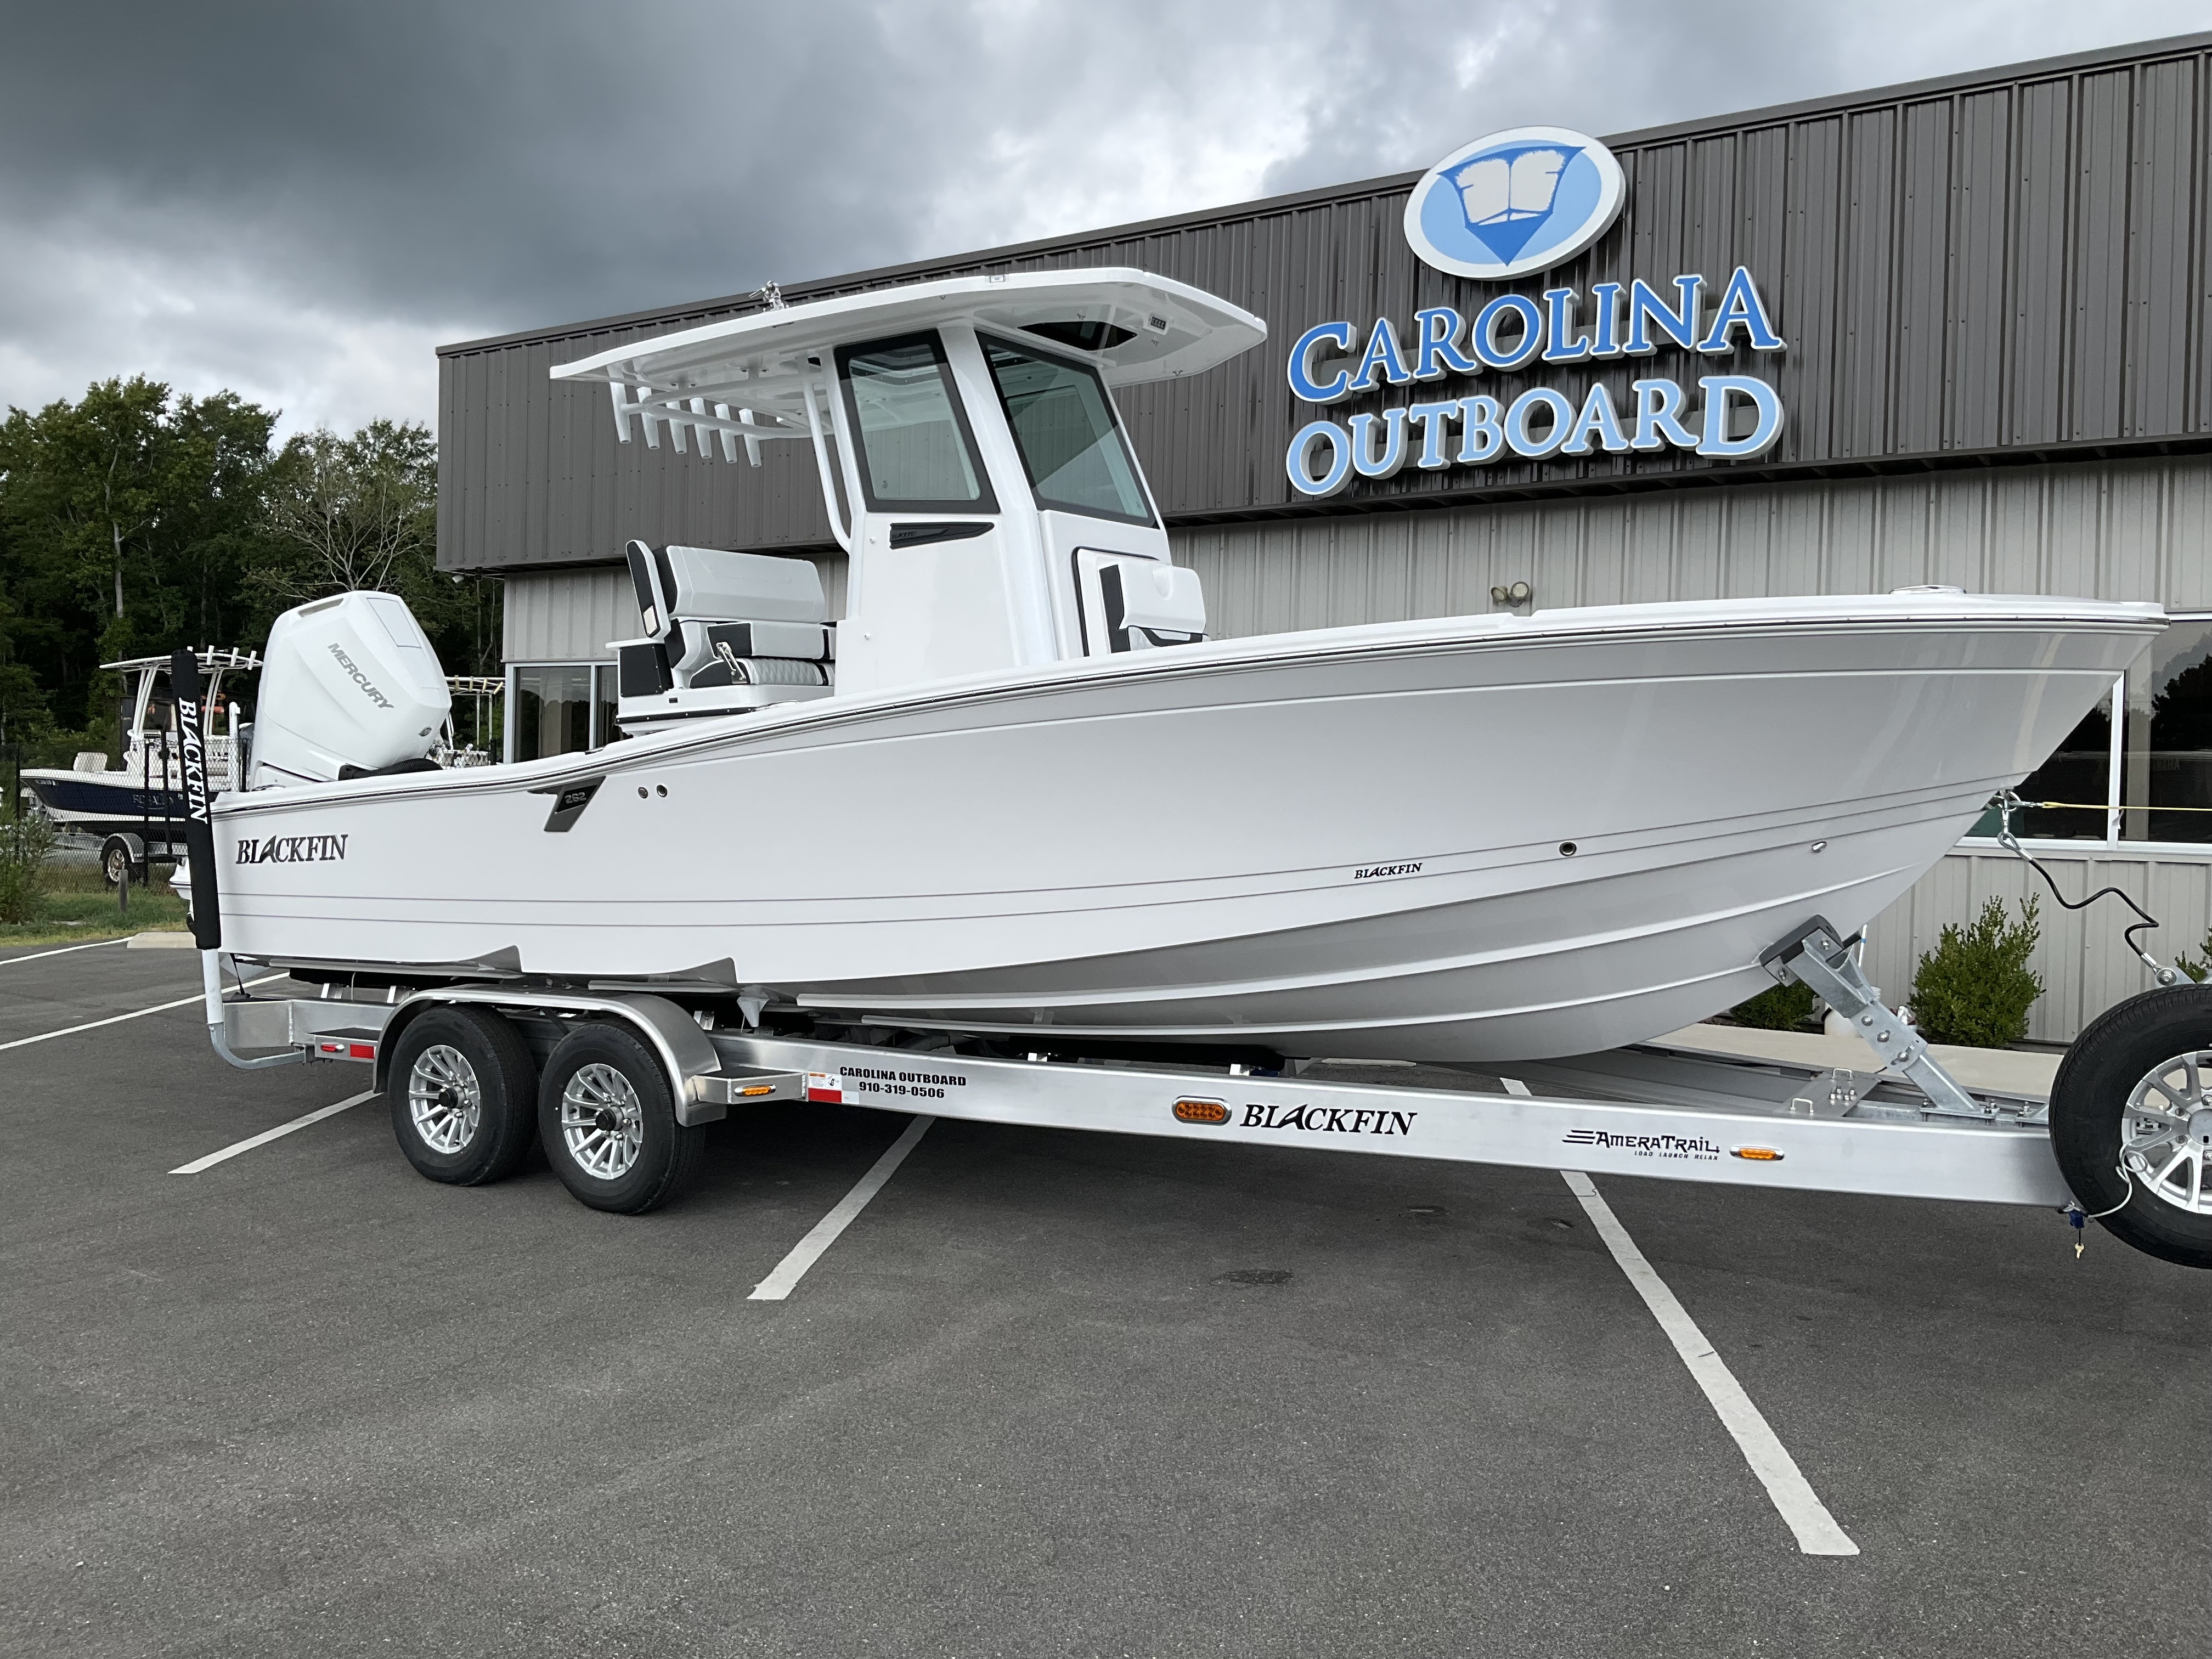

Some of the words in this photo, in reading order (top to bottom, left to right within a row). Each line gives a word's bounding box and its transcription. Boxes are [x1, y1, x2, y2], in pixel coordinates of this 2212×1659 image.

[1287, 265, 1786, 405] CAROLINA
[1285, 375, 1784, 498] OUTBOARD
[327, 642, 395, 709] MERCURY
[178, 697, 208, 825] BLACKFIN
[565, 792, 587, 804] 262
[235, 833, 349, 865] BLACKFIN
[1353, 862, 1423, 879] BLACKFIN
[839, 1066, 896, 1081] CAROLINA
[899, 1071, 967, 1086] OUTBOARD
[859, 1081, 945, 1098] 910-319-0506
[1239, 1103, 1418, 1136] BLACKFIN
